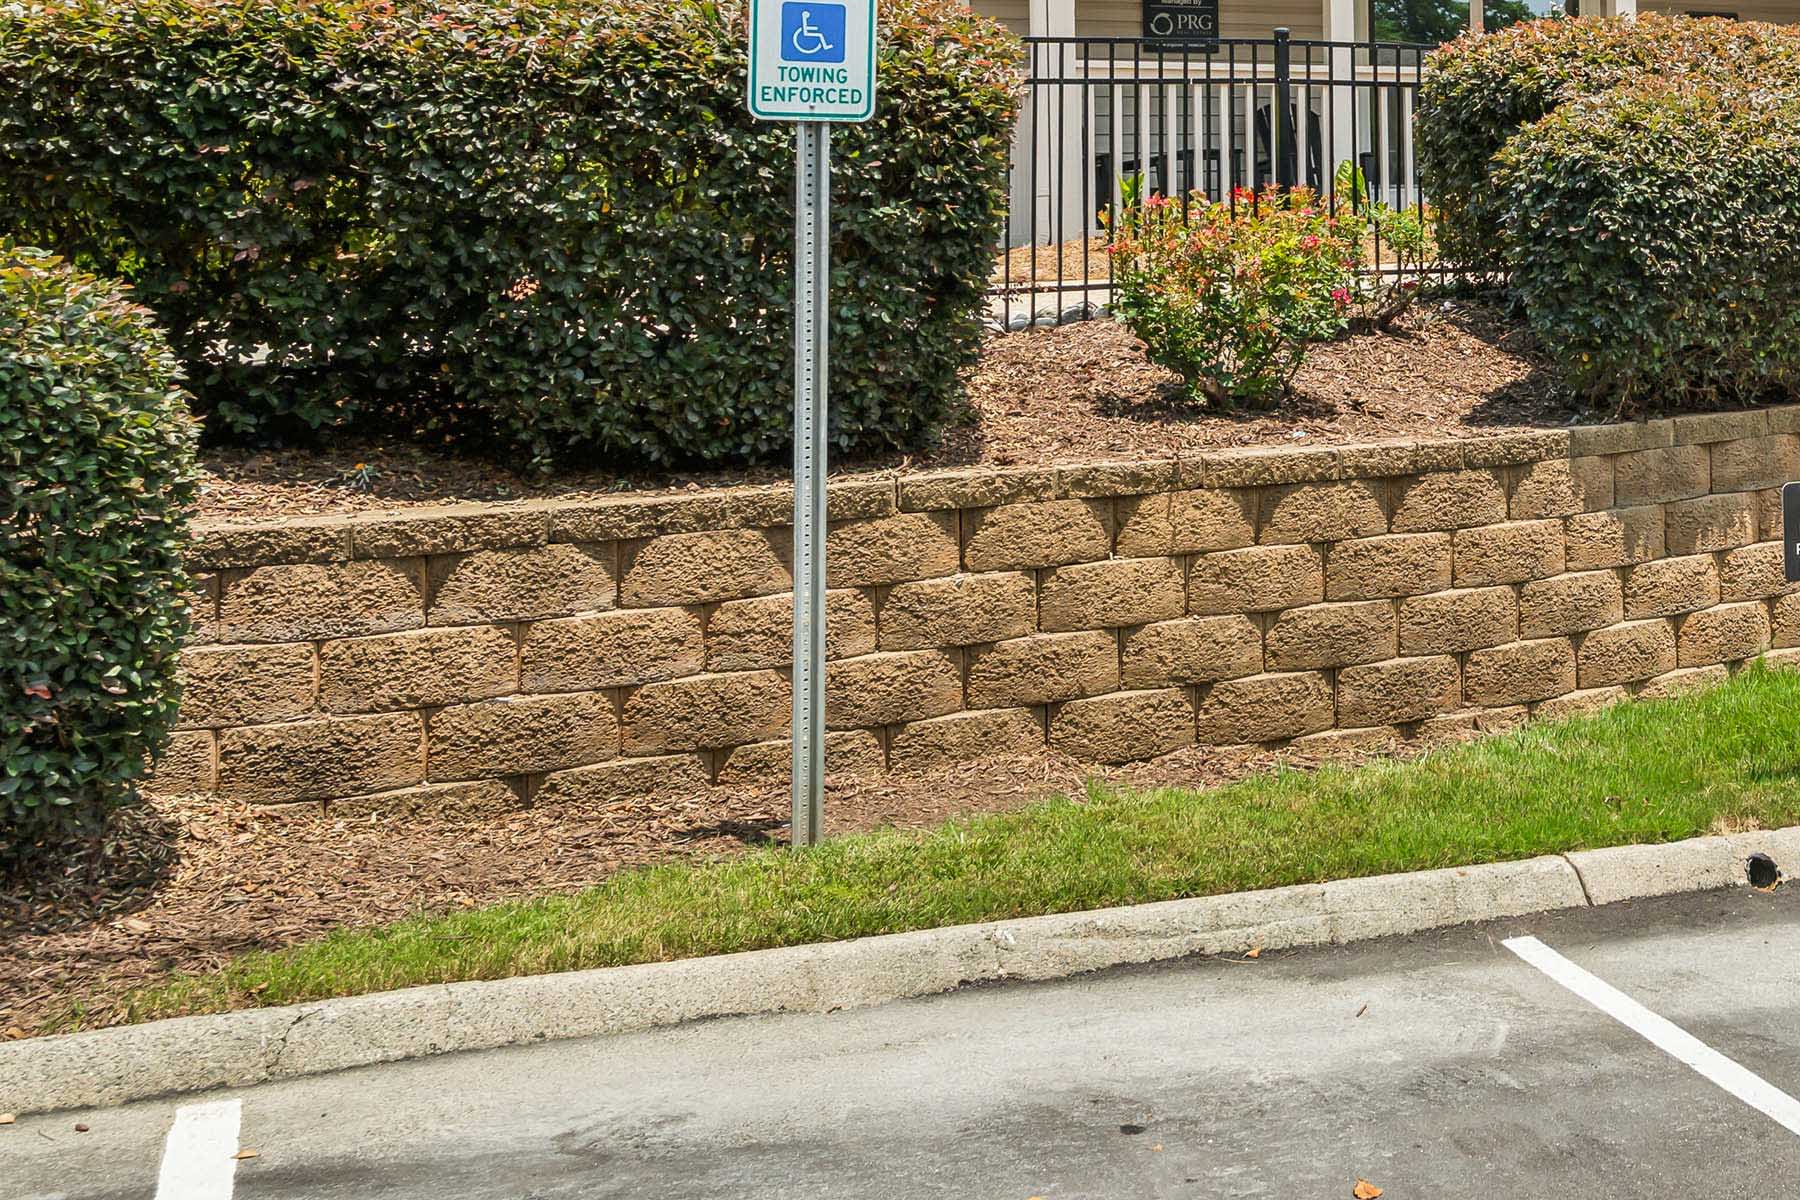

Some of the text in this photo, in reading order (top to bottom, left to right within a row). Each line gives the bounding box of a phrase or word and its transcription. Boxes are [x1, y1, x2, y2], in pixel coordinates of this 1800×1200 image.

[1177, 14, 1213, 30] PRG
[778, 66, 848, 83] TOWING
[761, 86, 862, 104] ENFORCED
